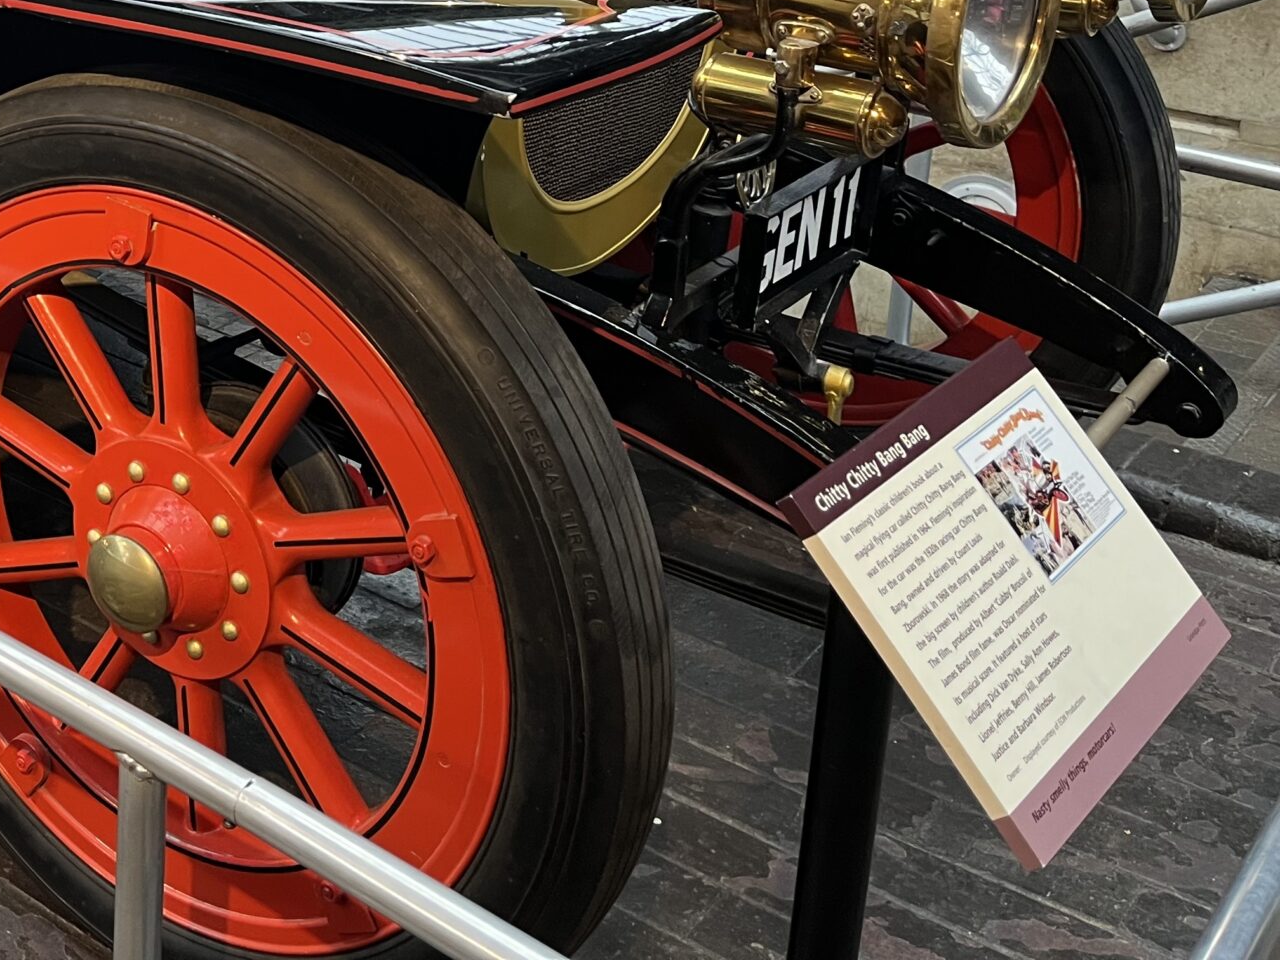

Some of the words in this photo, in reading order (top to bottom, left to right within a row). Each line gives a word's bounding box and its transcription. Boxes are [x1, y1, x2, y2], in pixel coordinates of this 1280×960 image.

[829, 166, 861, 248] 11
[496, 375, 566, 498] UNIVERSAL
[561, 509, 587, 558] TIRE
[814, 481, 851, 511] Chitty
[846, 459, 881, 488] Chitty
[875, 441, 907, 467] Bang
[899, 424, 930, 448] Bang
[840, 532, 852, 543] Ian
[874, 502, 891, 518] classic
[910, 474, 925, 489] book
[924, 464, 940, 479] about
[854, 539, 875, 561] magical
[872, 529, 891, 545] flying
[888, 522, 898, 533] car
[896, 509, 913, 527] called
[909, 500, 928, 515] Chitty
[924, 488, 942, 503] Chitty
[938, 479, 954, 492] Bang
[950, 469, 966, 483] Bang
[866, 565, 879, 578] was
[875, 556, 890, 569] first
[888, 535, 914, 563] published
[951, 485, 976, 509] inspiration
[877, 585, 888, 597] for
[886, 578, 898, 589] the
[896, 570, 906, 581] car
[904, 562, 917, 575] was
[914, 555, 925, 566] the
[937, 531, 955, 547] racing
[951, 524, 960, 535] car
[958, 513, 976, 528] Chitty
[972, 503, 988, 517] Bang
[906, 581, 925, 602] owned
[923, 572, 935, 587] and
[933, 561, 950, 578] driven
[946, 555, 957, 565] by
[953, 543, 971, 559] Count
[967, 533, 983, 547] Louis
[915, 639, 927, 651] the
[923, 631, 937, 642] big
[934, 617, 952, 635] screen
[947, 610, 959, 621] by
[977, 576, 994, 595] author
[991, 563, 1007, 581] Roald
[929, 600, 938, 609] In
[935, 588, 950, 603] 1968
[947, 582, 958, 593] the
[956, 571, 971, 586] story
[968, 562, 980, 575] was
[978, 544, 998, 566] adapted
[995, 540, 1005, 549] for
[927, 656, 941, 668] The
[951, 621, 975, 650] produced
[971, 617, 983, 627] by
[979, 603, 997, 621] Albert
[940, 669, 958, 688] James
[955, 655, 971, 673] Bond
[968, 647, 981, 660] film
[992, 625, 1004, 638] was
[1001, 612, 1016, 629] Oscar
[1014, 588, 1040, 617] nominated
[1036, 584, 1046, 595] for
[952, 695, 962, 705] its
[960, 675, 980, 699] musical
[995, 639, 1018, 664] featured
[1017, 626, 1032, 641] host
[1035, 612, 1047, 626] stars
[966, 698, 991, 725] including
[987, 687, 1001, 702] Dick
[997, 678, 1010, 691] Van
[1020, 654, 1035, 669] Sally
[1031, 645, 1044, 658] Ann
[977, 721, 996, 743] Lionel
[1010, 690, 1029, 709] Benny
[1034, 666, 1051, 684] James
[1047, 644, 1072, 670] Robertson
[991, 741, 1010, 762] Justice
[1008, 728, 1019, 744] and
[1015, 712, 1037, 735] Barbara
[1031, 799, 1051, 823] Nasty
[1049, 778, 1070, 804] smelly
[1067, 757, 1088, 781] things,
[1086, 721, 1116, 760] motorcars!
